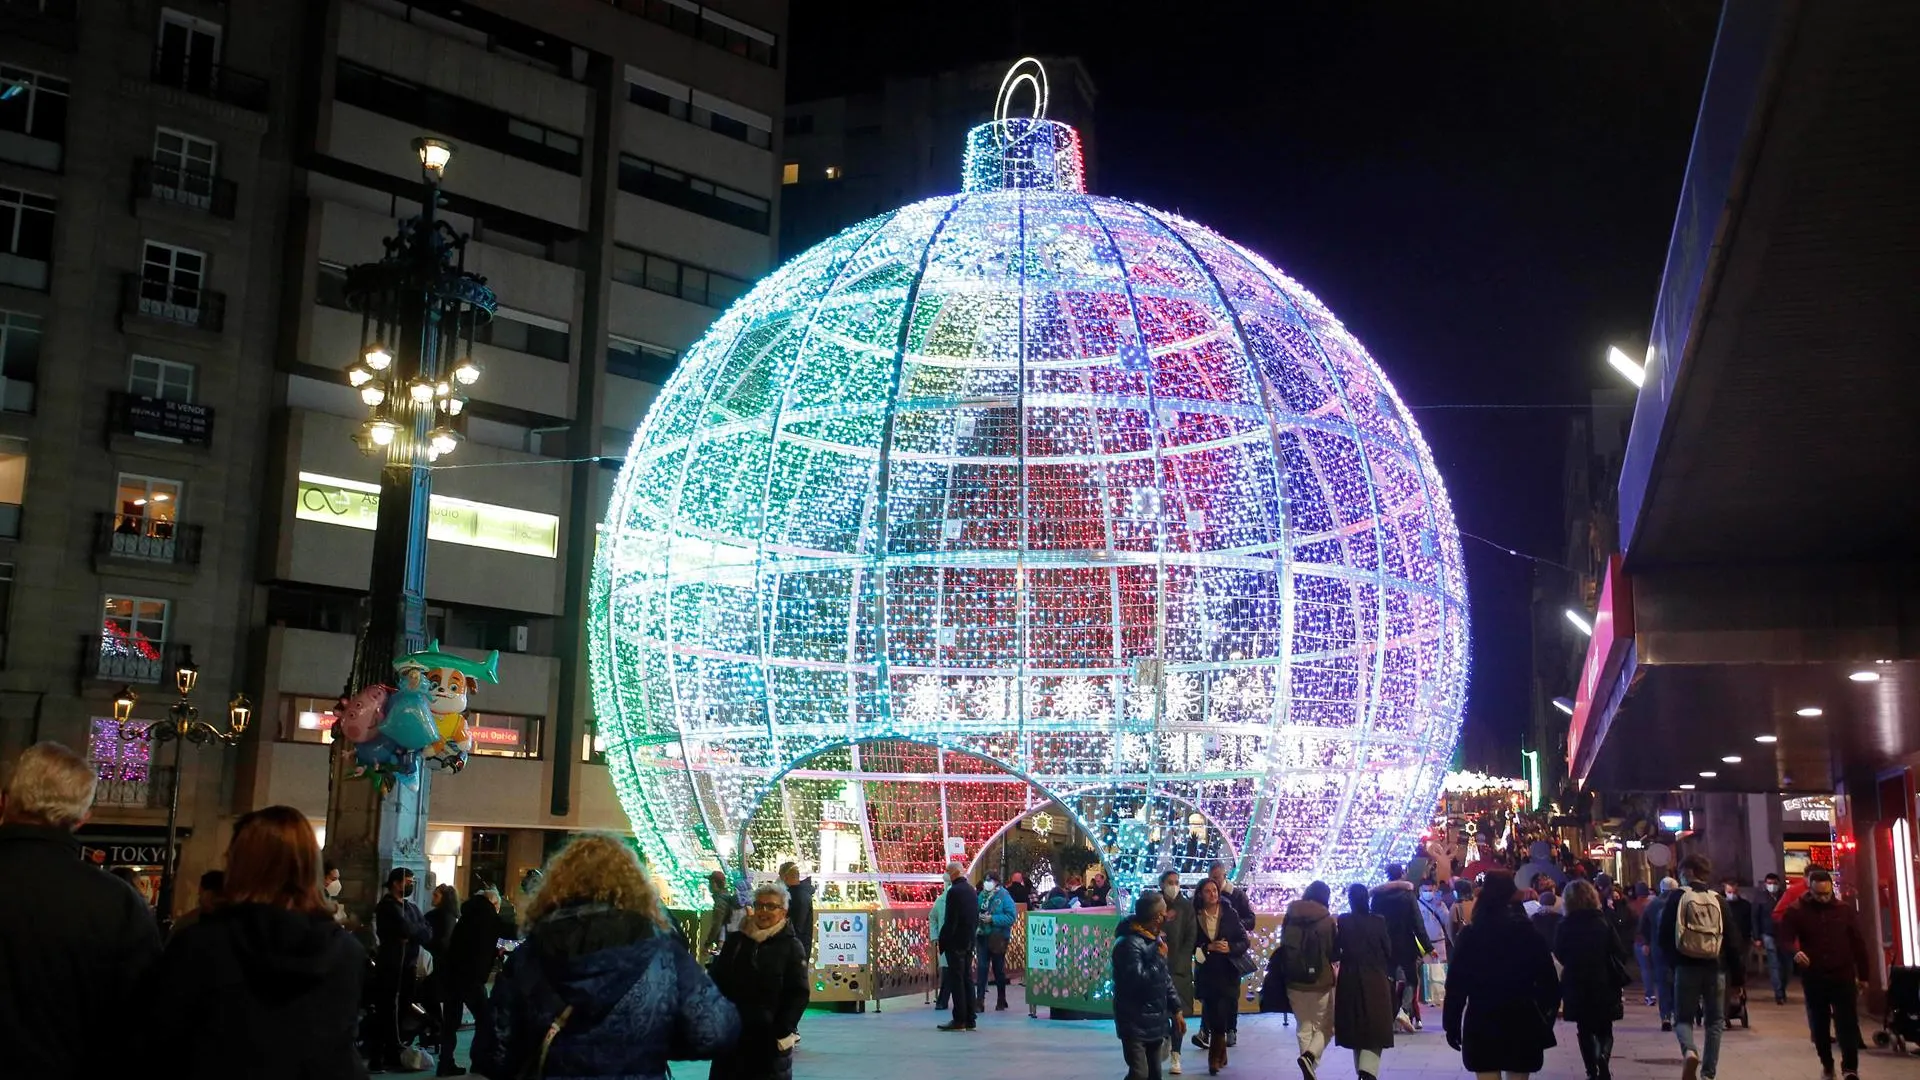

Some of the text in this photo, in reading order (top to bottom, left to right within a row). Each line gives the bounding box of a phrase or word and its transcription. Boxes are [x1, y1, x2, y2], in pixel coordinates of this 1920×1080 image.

[166, 401, 206, 416] SE VENDE
[110, 846, 177, 862] TOKYO
[828, 942, 857, 950] SALIDA
